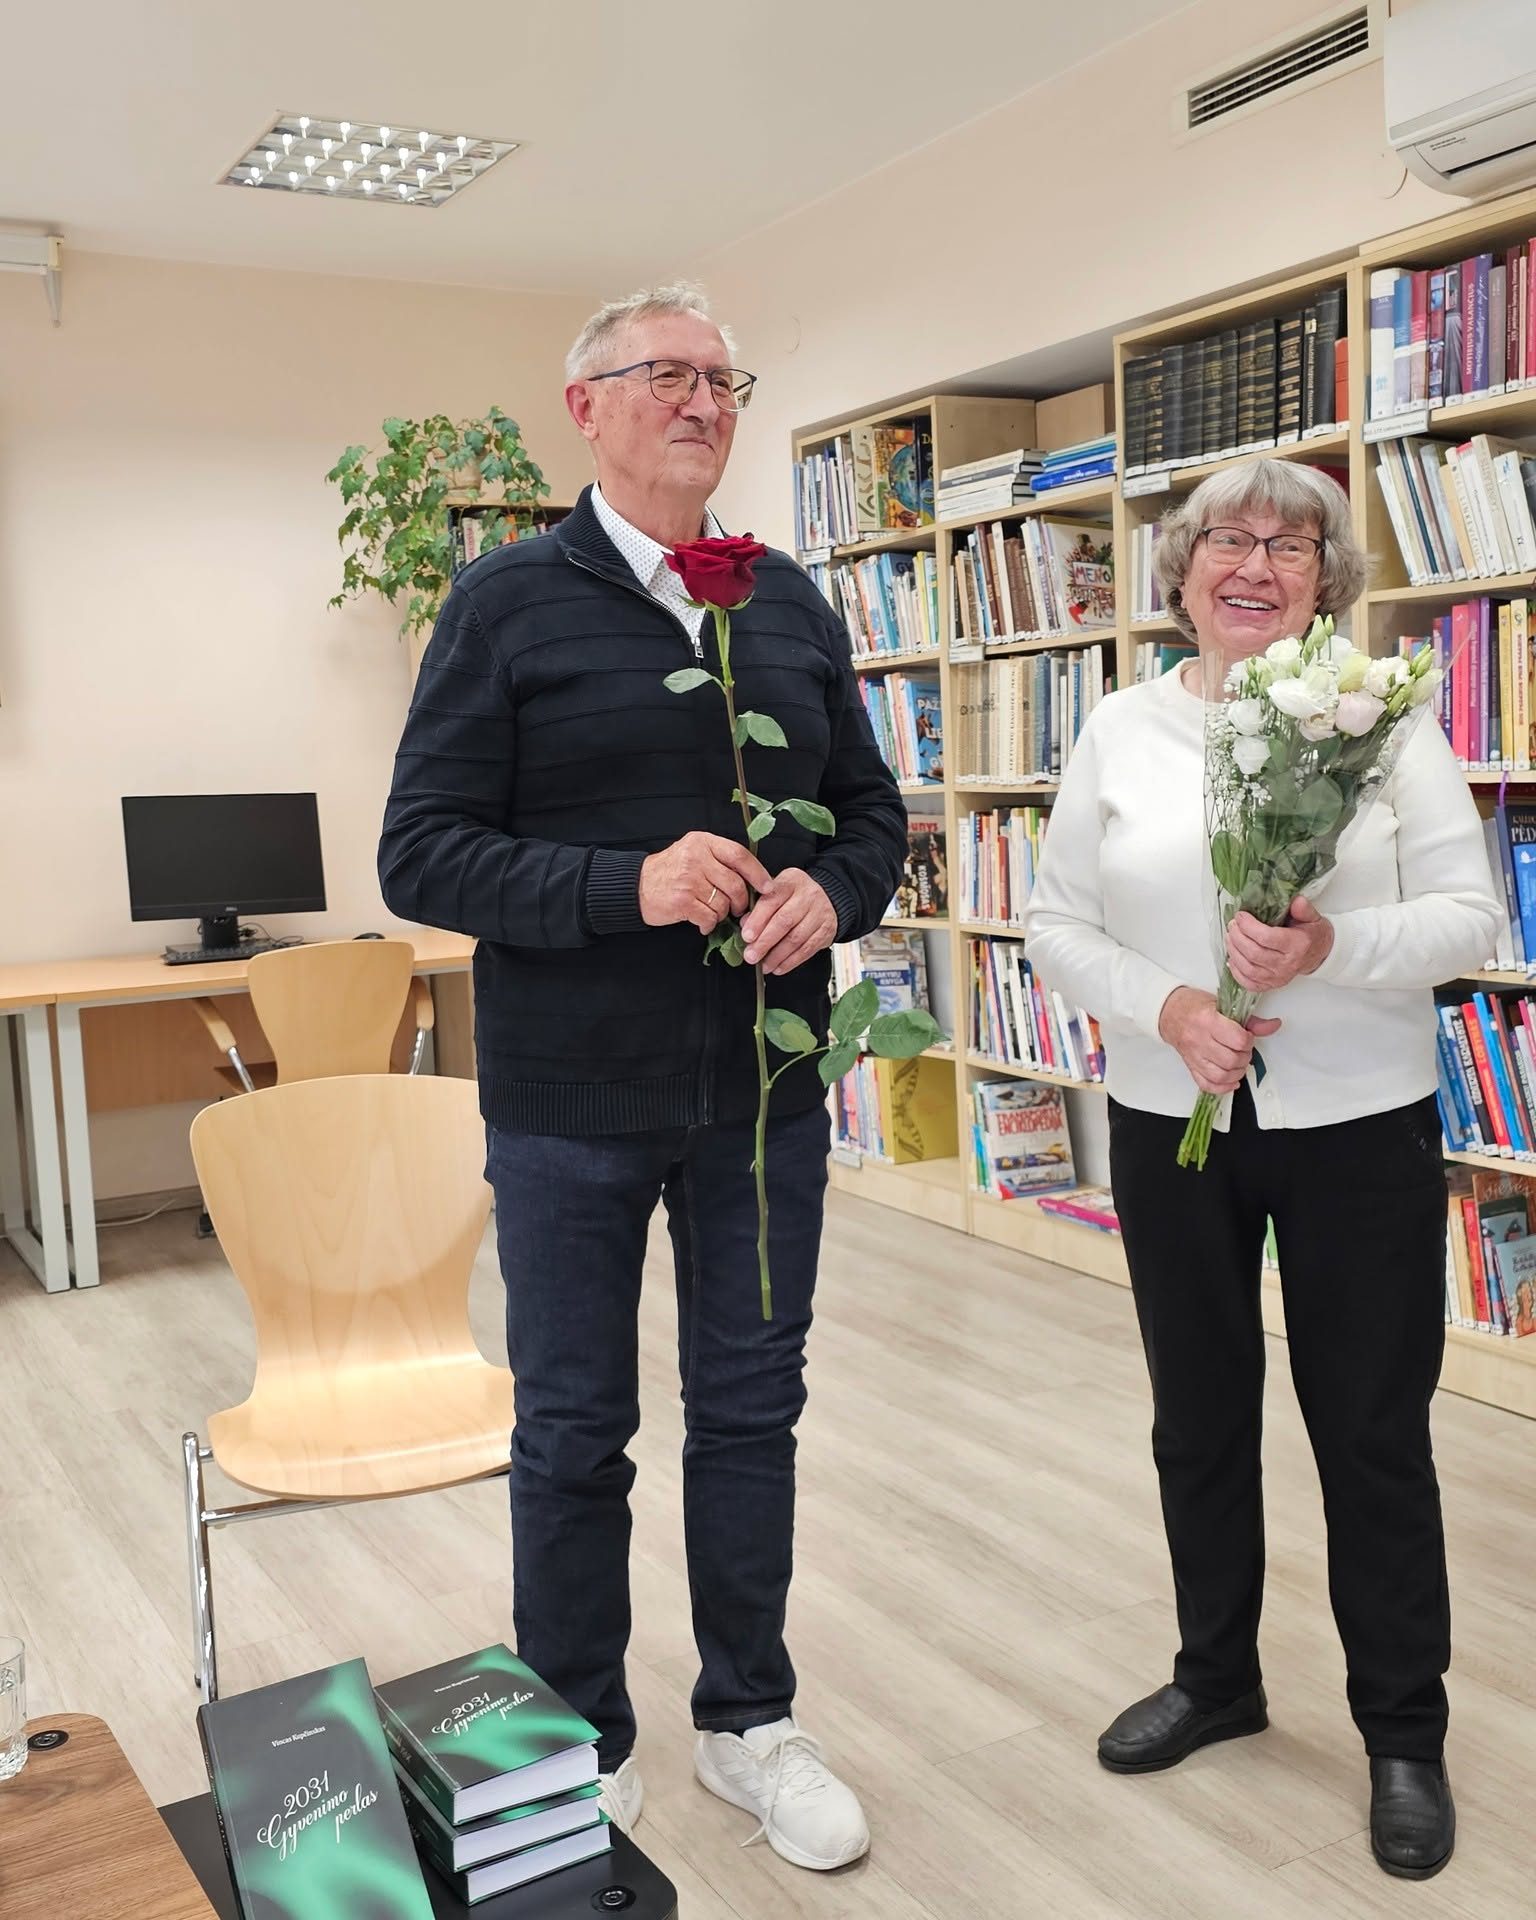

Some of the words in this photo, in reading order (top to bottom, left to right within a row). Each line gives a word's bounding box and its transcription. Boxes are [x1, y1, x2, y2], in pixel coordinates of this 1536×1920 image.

[431, 1696, 508, 1736] Gyvenimo
[452, 1692, 491, 1719] 2031
[499, 1691, 535, 1720] perlas
[284, 1770, 329, 1818] 2031
[335, 1782, 378, 1843] perlas
[256, 1790, 348, 1861] Gyvenimo
